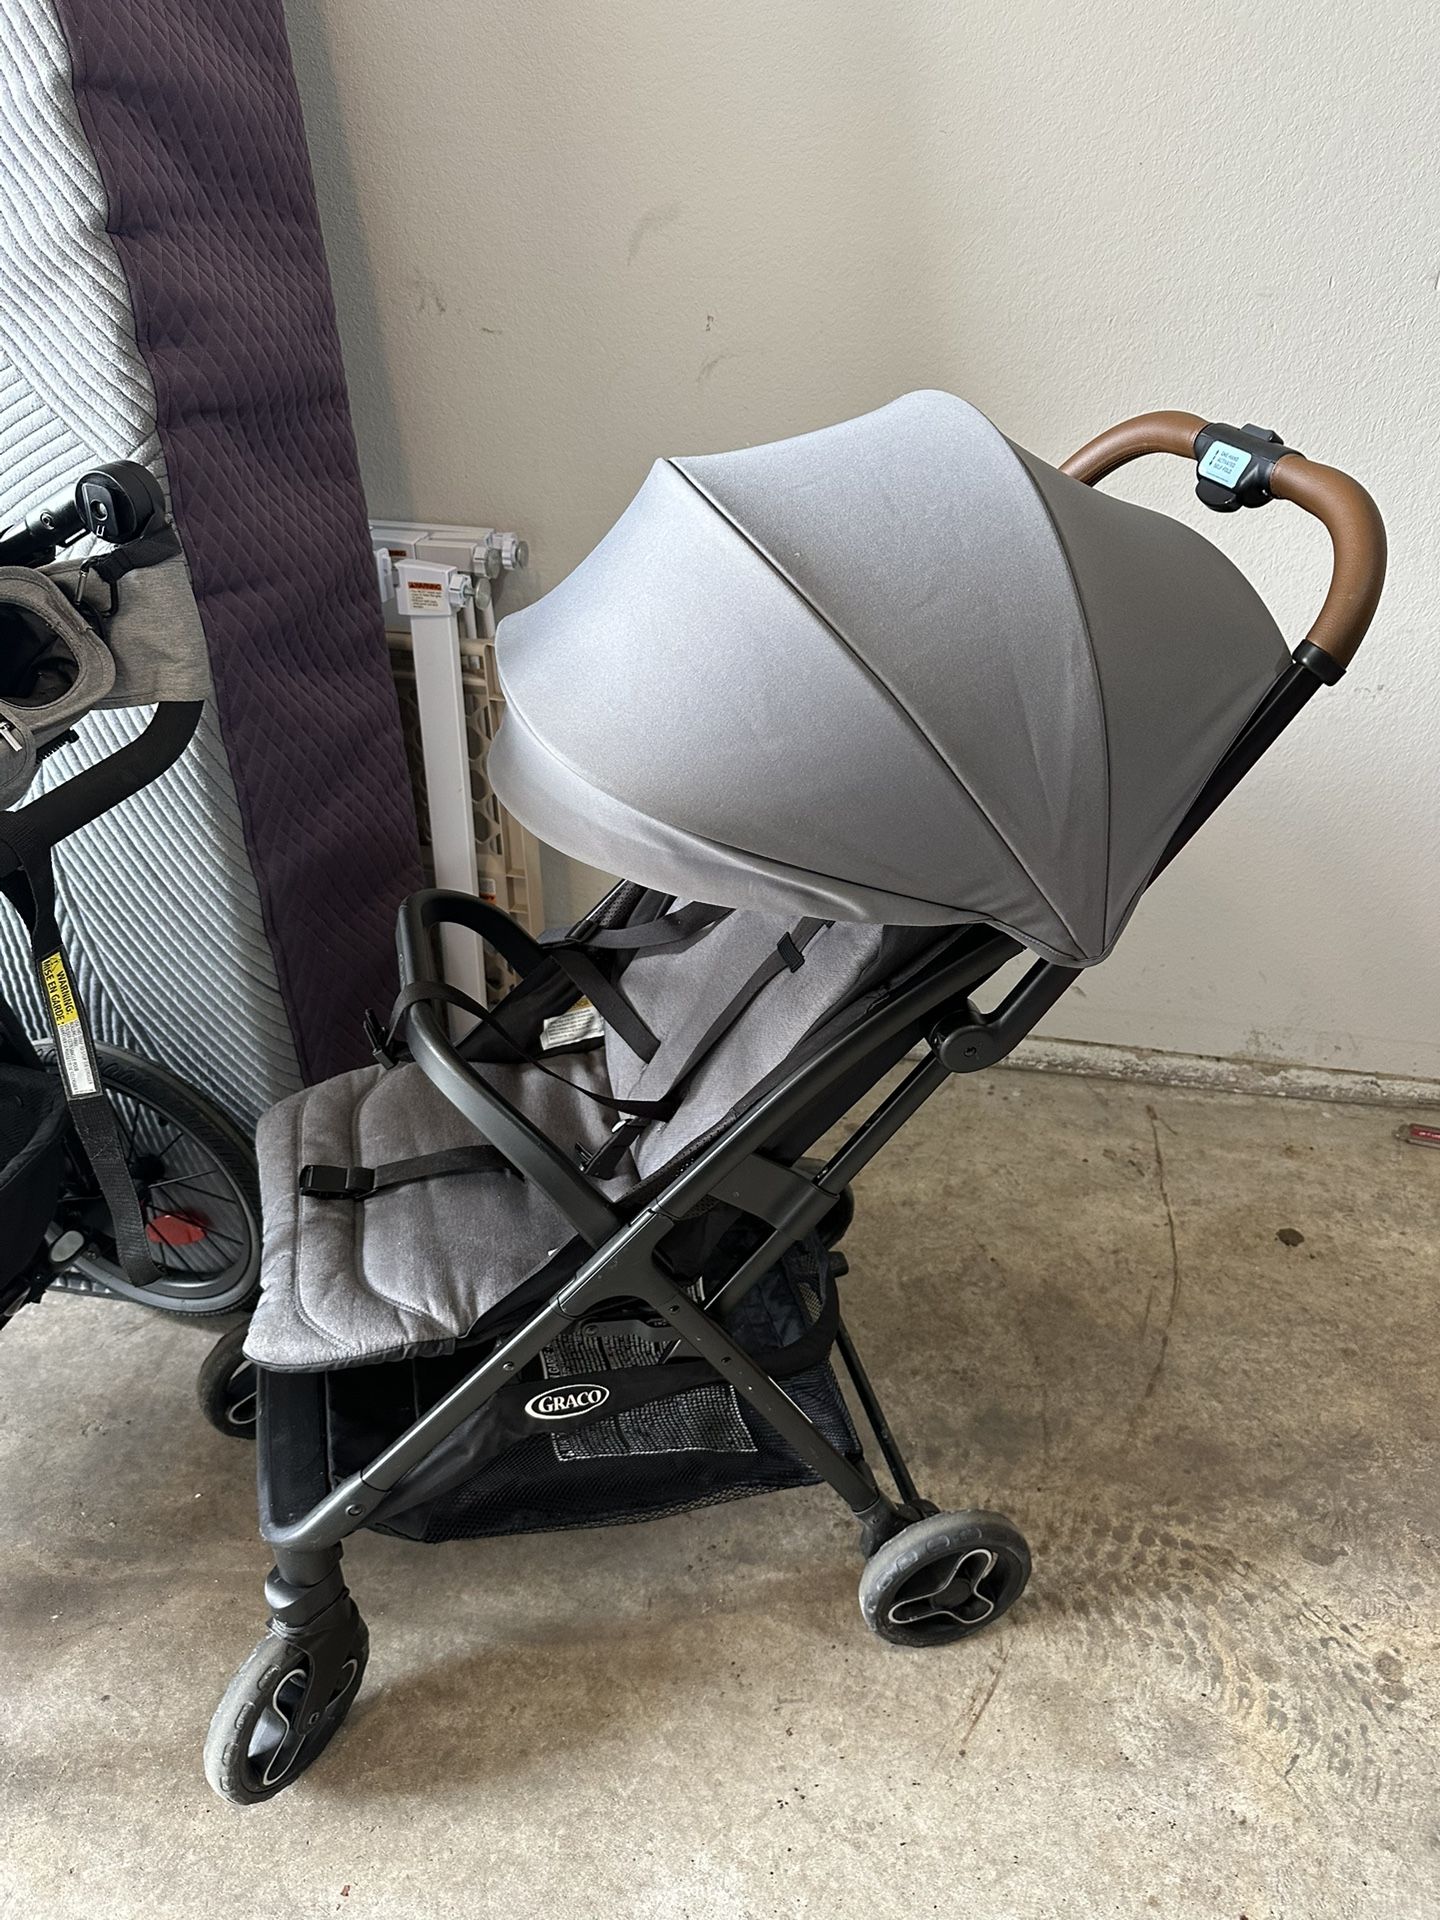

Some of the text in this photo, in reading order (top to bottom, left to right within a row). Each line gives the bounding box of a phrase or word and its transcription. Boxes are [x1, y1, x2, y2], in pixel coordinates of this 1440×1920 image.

[43, 960, 54, 981] MISE
[47, 981, 58, 994] EN
[56, 970, 75, 1015] WARNING:
[538, 1389, 602, 1413] GRACO
